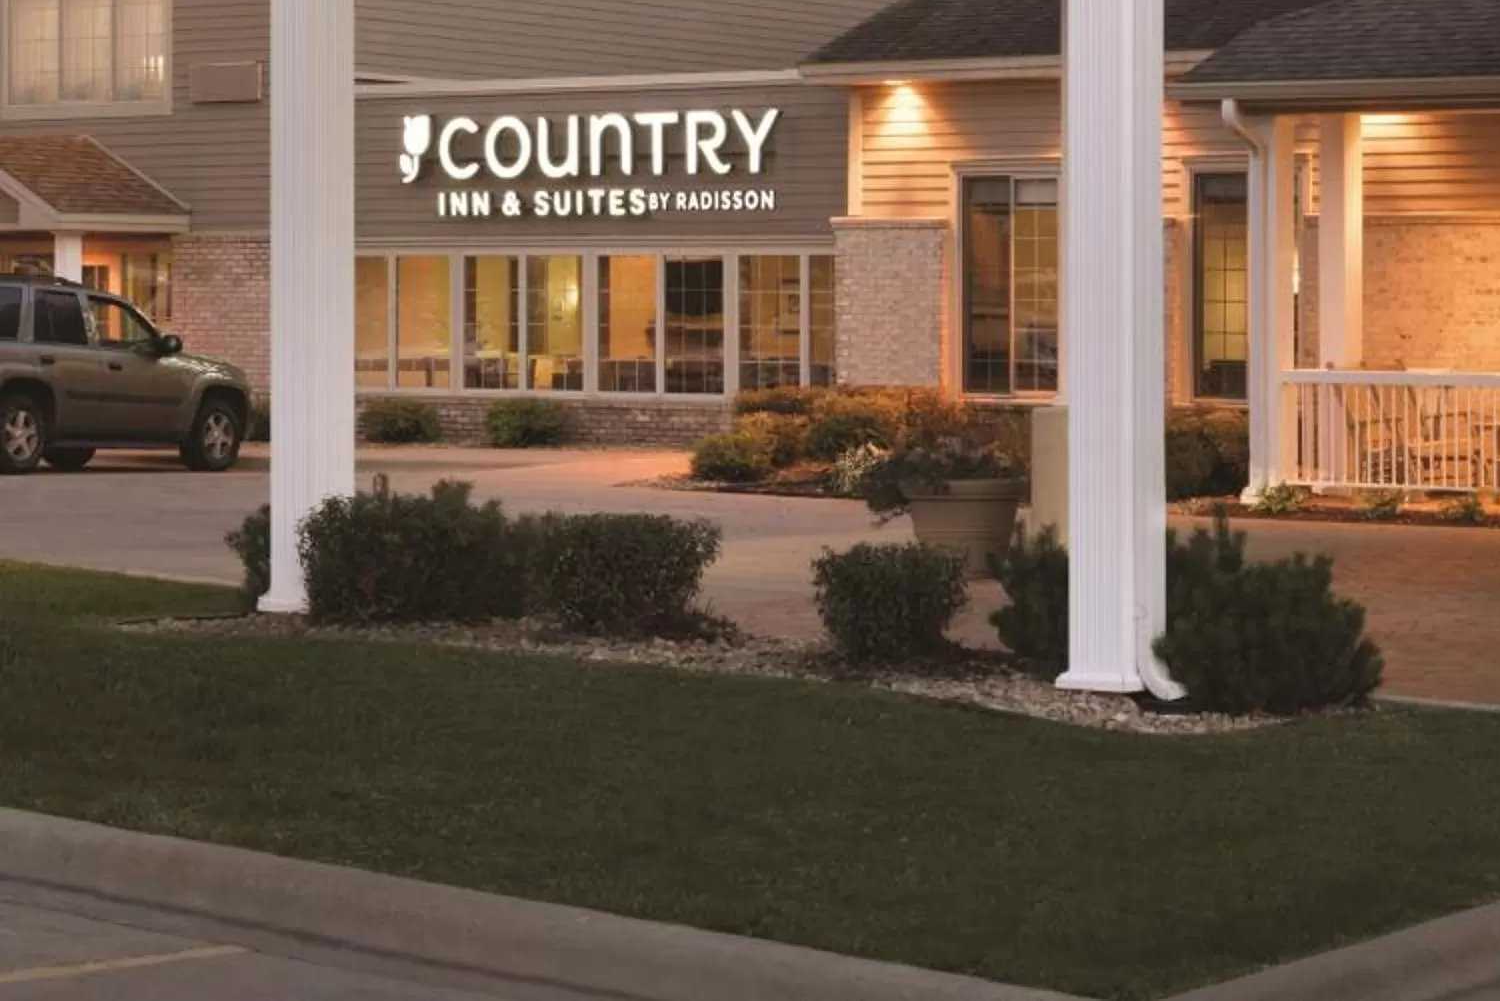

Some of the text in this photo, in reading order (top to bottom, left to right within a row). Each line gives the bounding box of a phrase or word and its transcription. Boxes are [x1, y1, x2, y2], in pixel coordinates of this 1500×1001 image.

[439, 108, 779, 180] COUNTRY
[438, 188, 775, 217] INN & SUITES BY RADISSON
